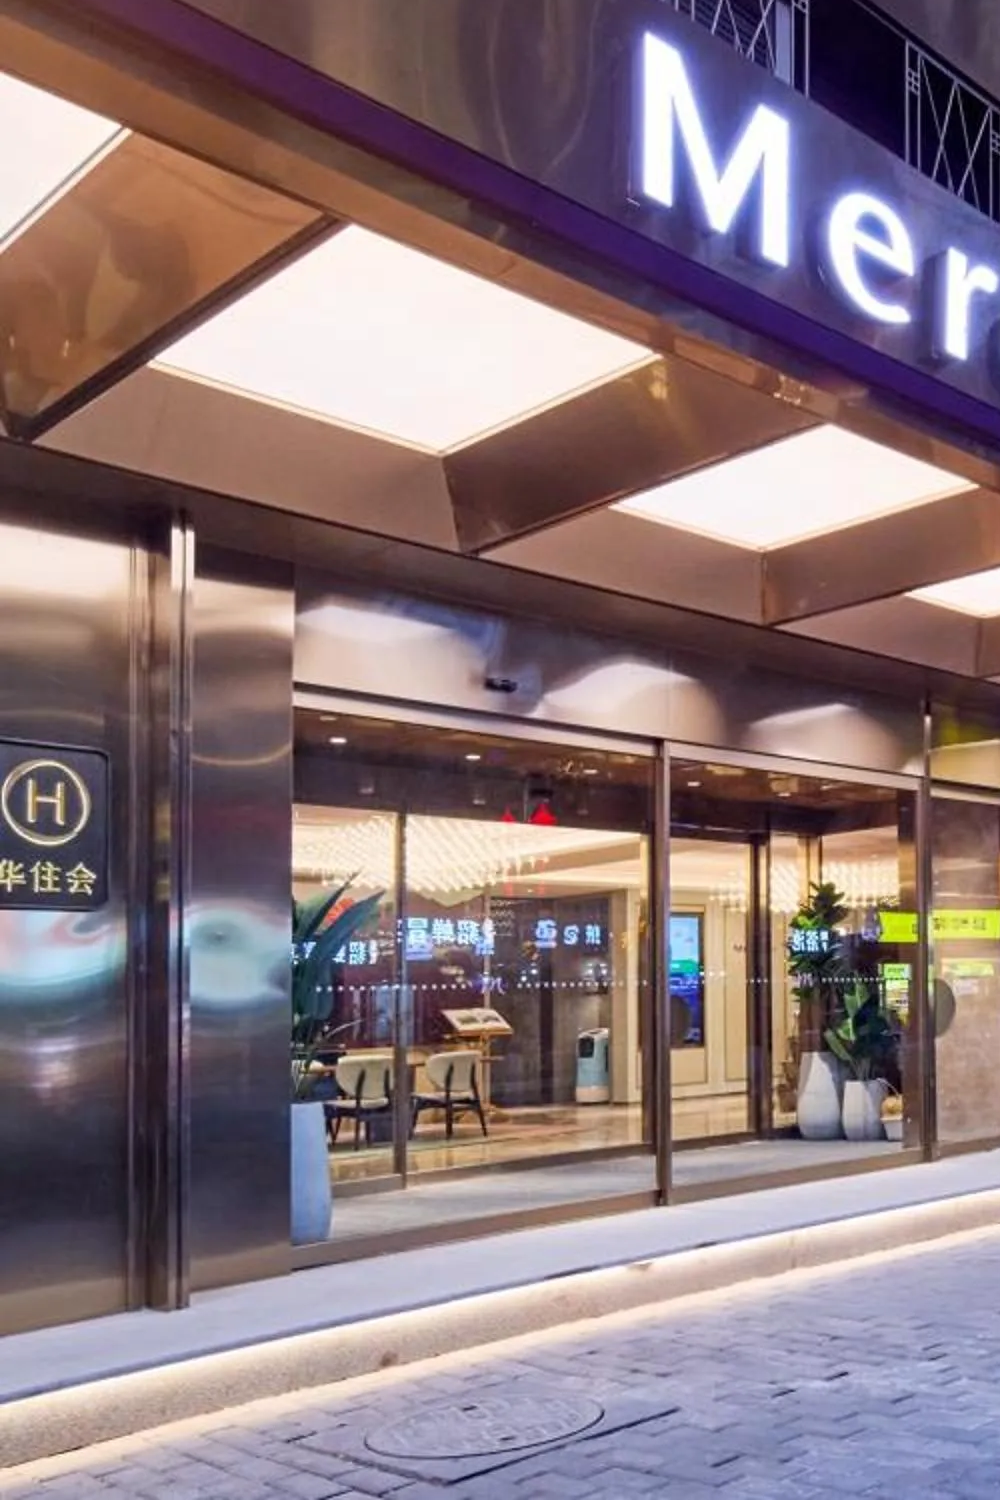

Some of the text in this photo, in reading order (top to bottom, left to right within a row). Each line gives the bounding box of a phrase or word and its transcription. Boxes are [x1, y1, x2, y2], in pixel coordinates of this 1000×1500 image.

[27, 778, 66, 826] H
[0, 858, 97, 896] 华住会
